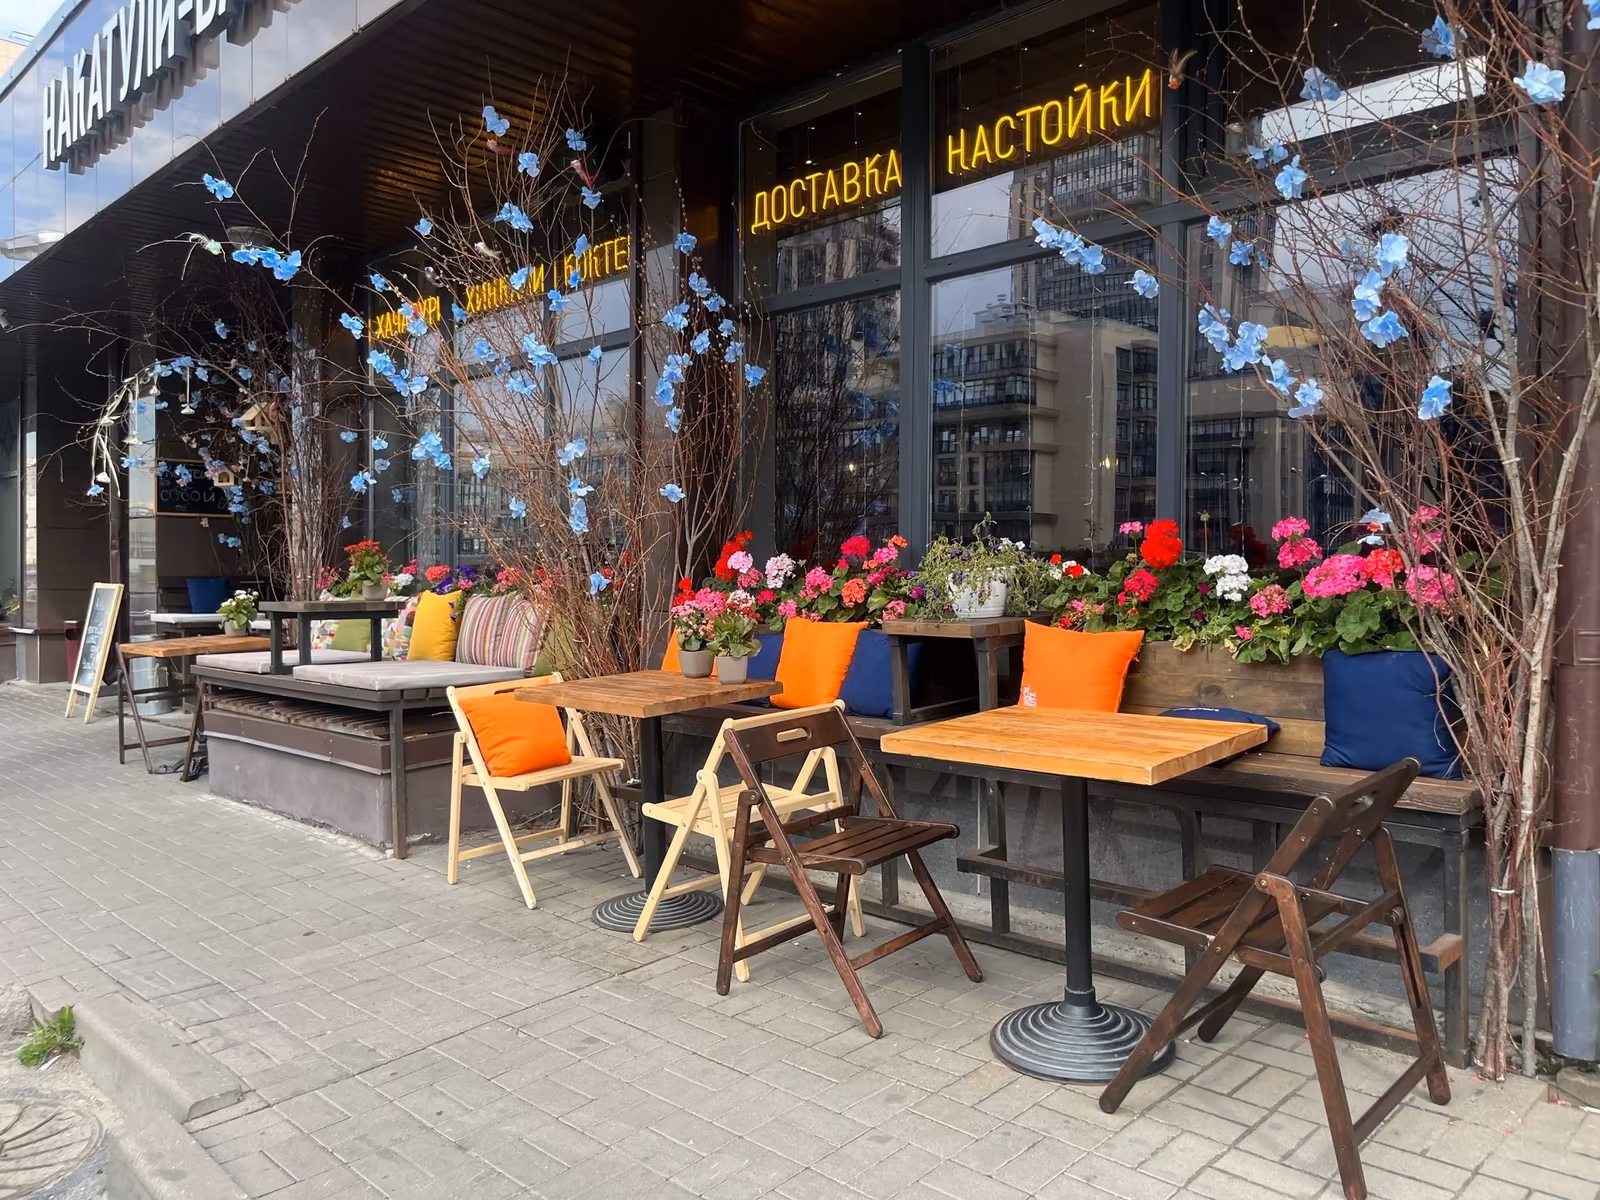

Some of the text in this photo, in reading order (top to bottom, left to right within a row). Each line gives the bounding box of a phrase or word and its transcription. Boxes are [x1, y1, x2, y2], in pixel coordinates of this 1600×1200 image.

[43, 0, 227, 169] НАКАТУЛИ-
[947, 68, 1152, 175] НАСТОЙКИ
[751, 148, 902, 235] ДОСТАВКА
